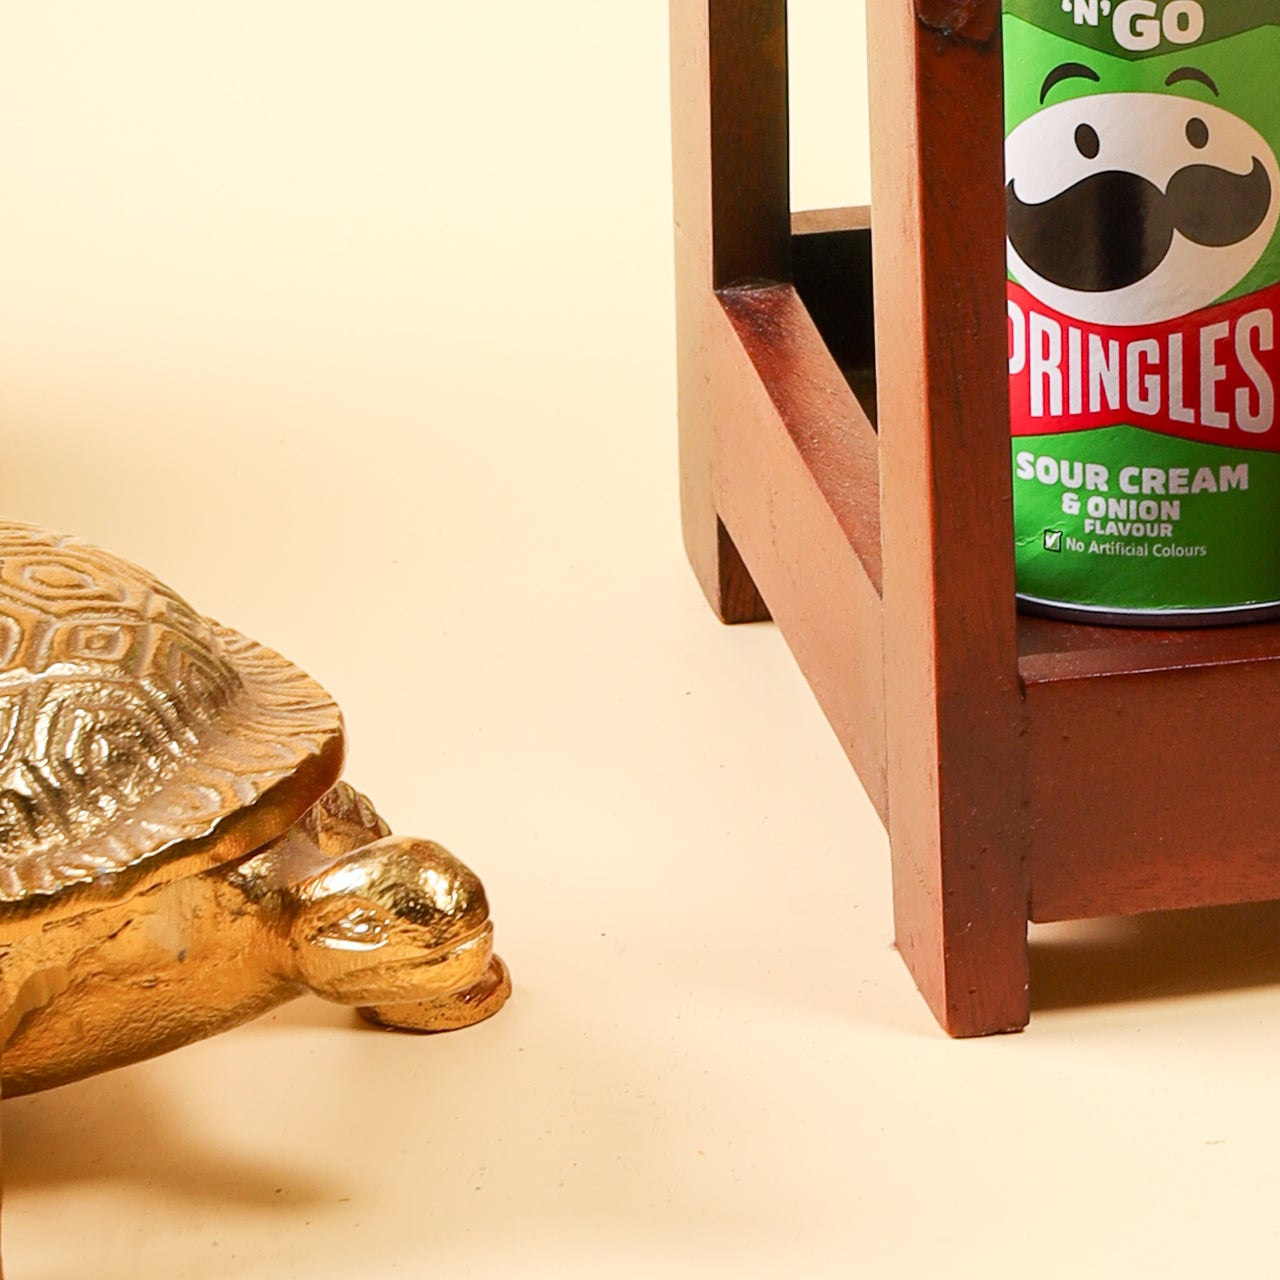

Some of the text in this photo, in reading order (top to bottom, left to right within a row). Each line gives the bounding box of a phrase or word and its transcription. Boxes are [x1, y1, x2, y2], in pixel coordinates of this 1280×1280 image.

[1016, 450, 1249, 495] SOUR CREAM
[1061, 492, 1181, 521] & ONION
[1083, 518, 1173, 538] FLAVOUR
[1066, 537, 1207, 557] No Artificial Colours
